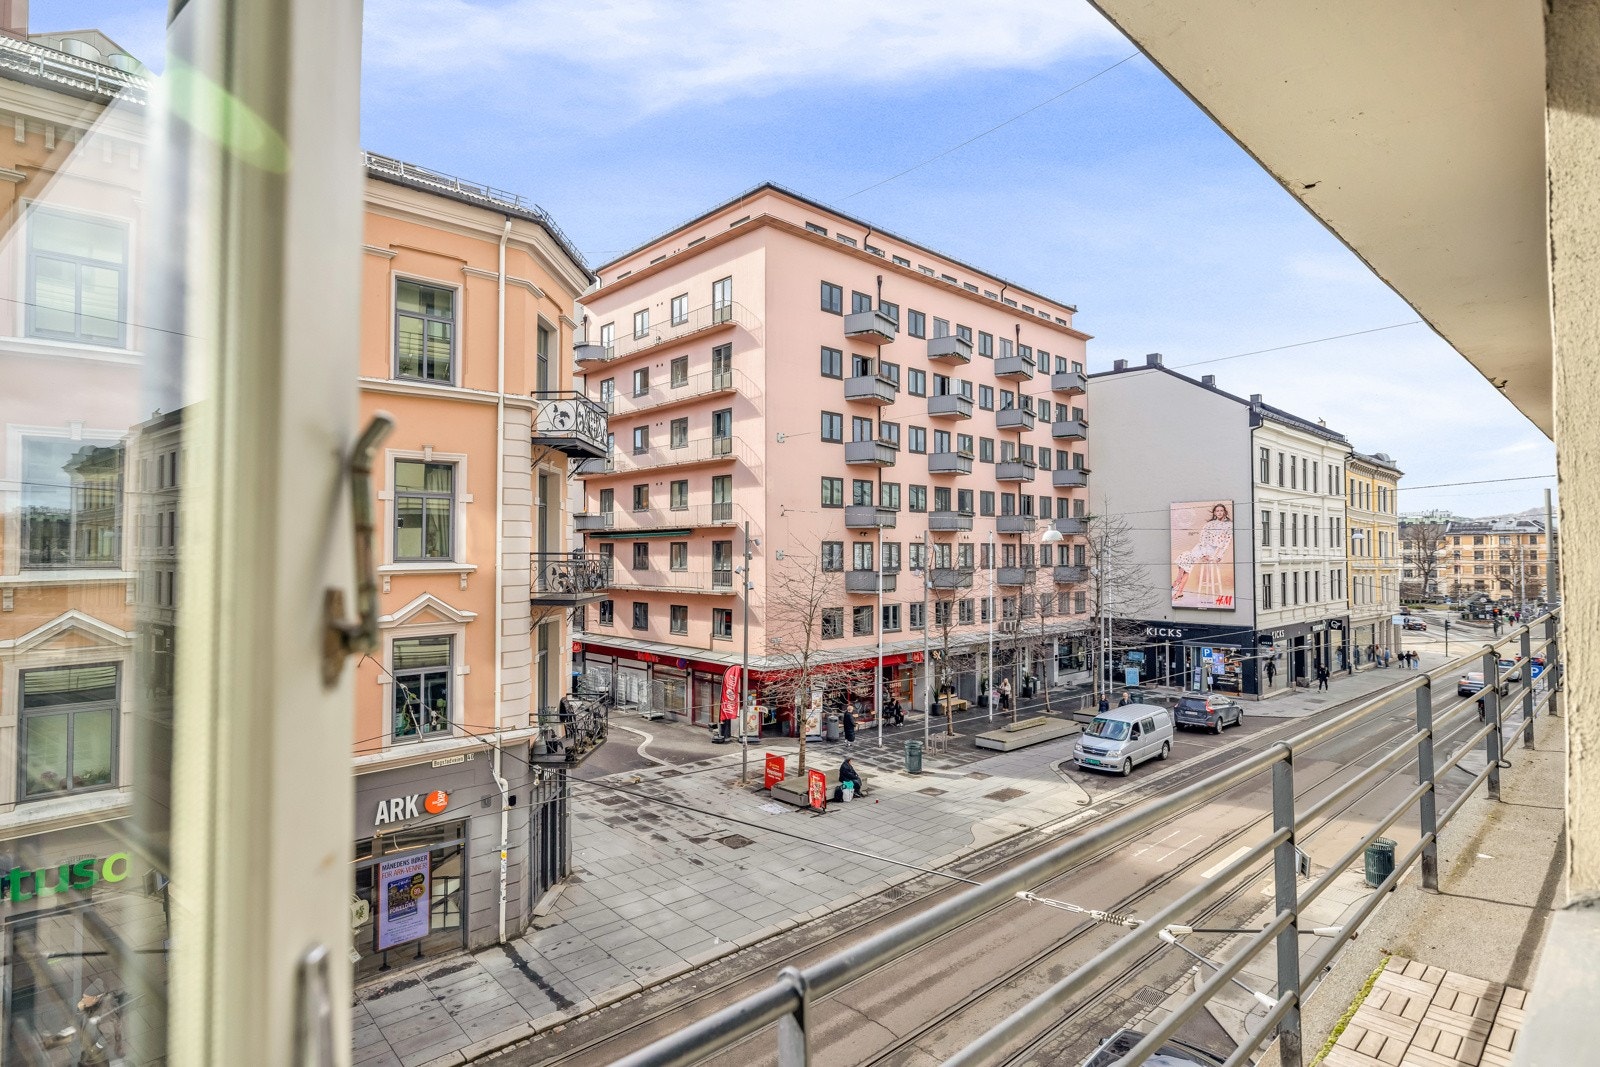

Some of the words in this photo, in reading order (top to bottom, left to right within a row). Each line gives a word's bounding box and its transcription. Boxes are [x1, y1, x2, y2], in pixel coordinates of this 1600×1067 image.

[1216, 595, 1233, 606] H&M
[1146, 627, 1182, 638] KICKS
[1271, 629, 1285, 639] KICKS
[374, 794, 419, 826] ARK
[381, 858, 411, 871] MÅNEDENS
[410, 855, 428, 864] BØKER
[381, 871, 393, 879] FOR
